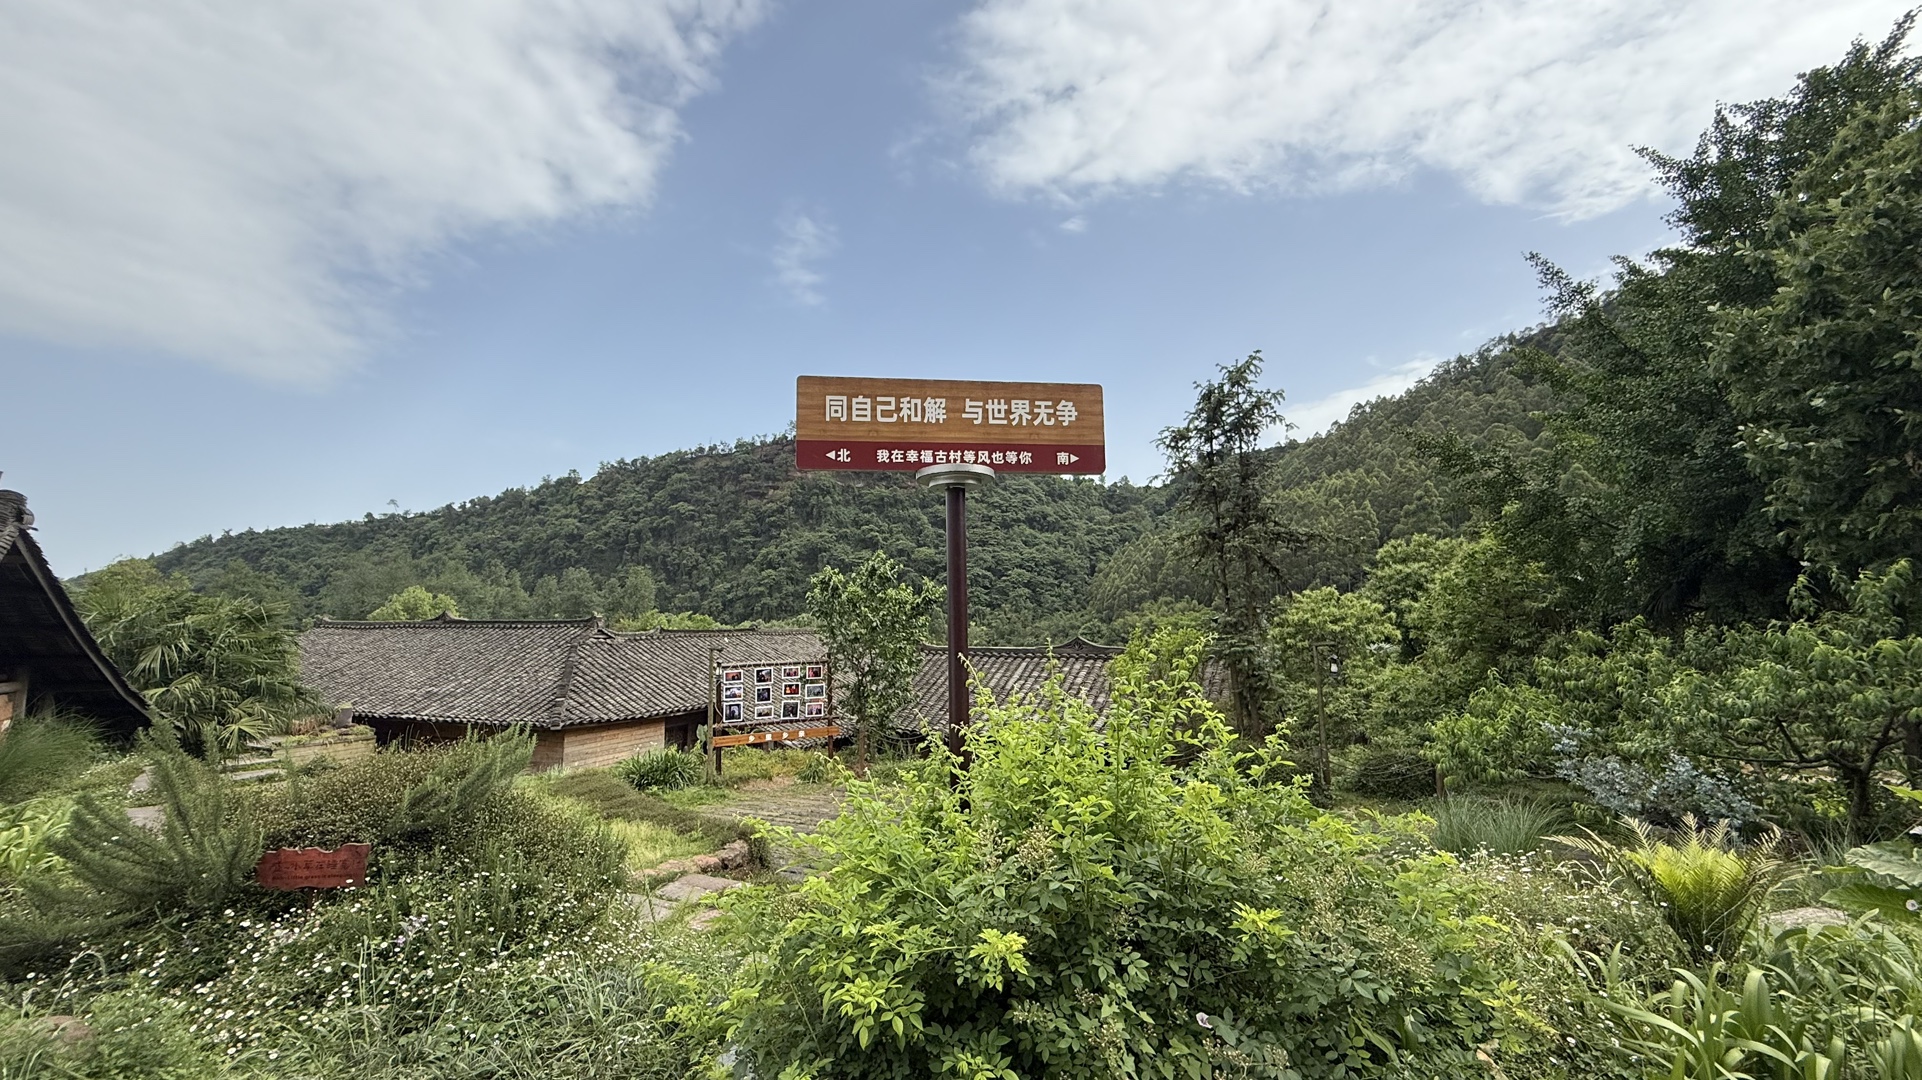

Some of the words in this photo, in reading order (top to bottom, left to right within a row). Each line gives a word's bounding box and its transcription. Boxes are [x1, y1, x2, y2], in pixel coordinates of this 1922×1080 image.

[825, 395, 947, 424] 同自己和解
[962, 398, 1078, 427] 与世界无争
[837, 448, 851, 463] 北
[876, 449, 1033, 465] 我在幸福古村等风也等你
[1056, 451, 1070, 466] 南
